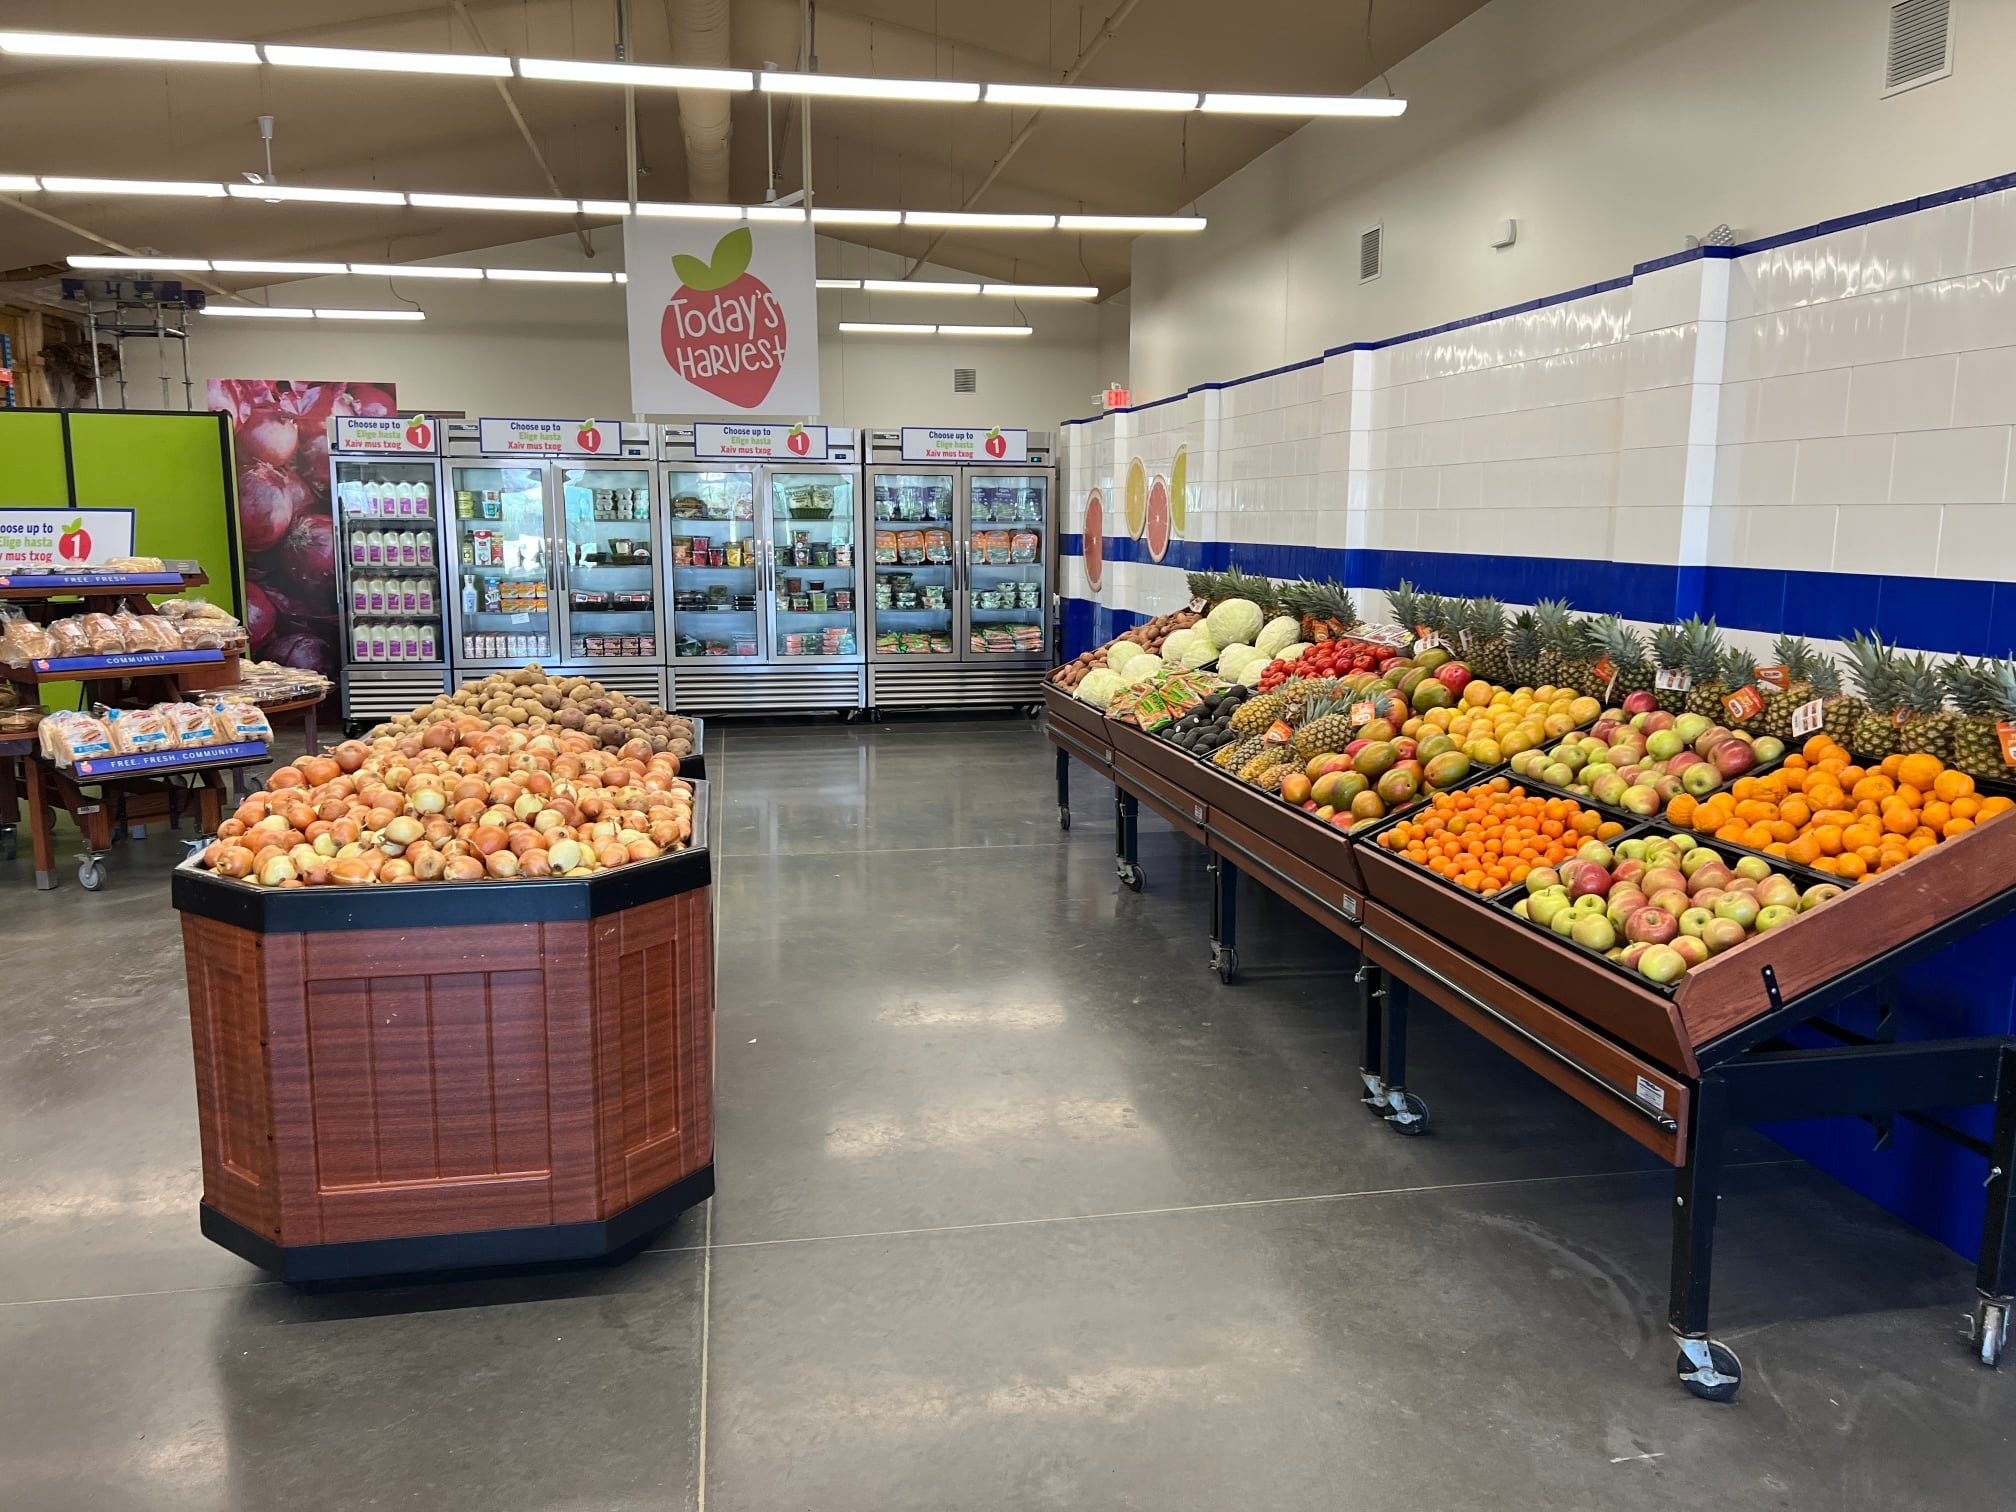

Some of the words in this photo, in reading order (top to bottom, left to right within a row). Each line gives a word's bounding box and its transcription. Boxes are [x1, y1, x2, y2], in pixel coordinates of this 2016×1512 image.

[665, 289, 779, 340] Today's
[1108, 390, 1128, 406] EXIT
[348, 420, 378, 428] Choose
[380, 422, 390, 430] up
[510, 422, 538, 430] Choose
[540, 424, 550, 432] up
[356, 430, 376, 439] Elige
[416, 428, 422, 444] 1
[724, 426, 750, 435] Choose
[752, 428, 761, 436] up
[929, 431, 954, 439] Choose
[519, 432, 538, 441] Elige
[540, 432, 561, 440] hasta
[586, 432, 593, 448] 1
[732, 436, 749, 445] Elige
[384, 441, 402, 450] txog
[508, 441, 524, 449] Xaiv
[544, 442, 562, 451] txog
[796, 434, 802, 450] 1
[936, 440, 953, 449] Elige
[992, 438, 1000, 454] 1
[756, 447, 772, 455] txog
[0, 524, 24, 533] oose
[27, 525, 39, 536] up
[43, 523, 53, 534] to
[25, 536, 52, 547] hasta
[71, 534, 80, 558] 1
[6, 552, 26, 561] mus
[30, 551, 52, 563] txog
